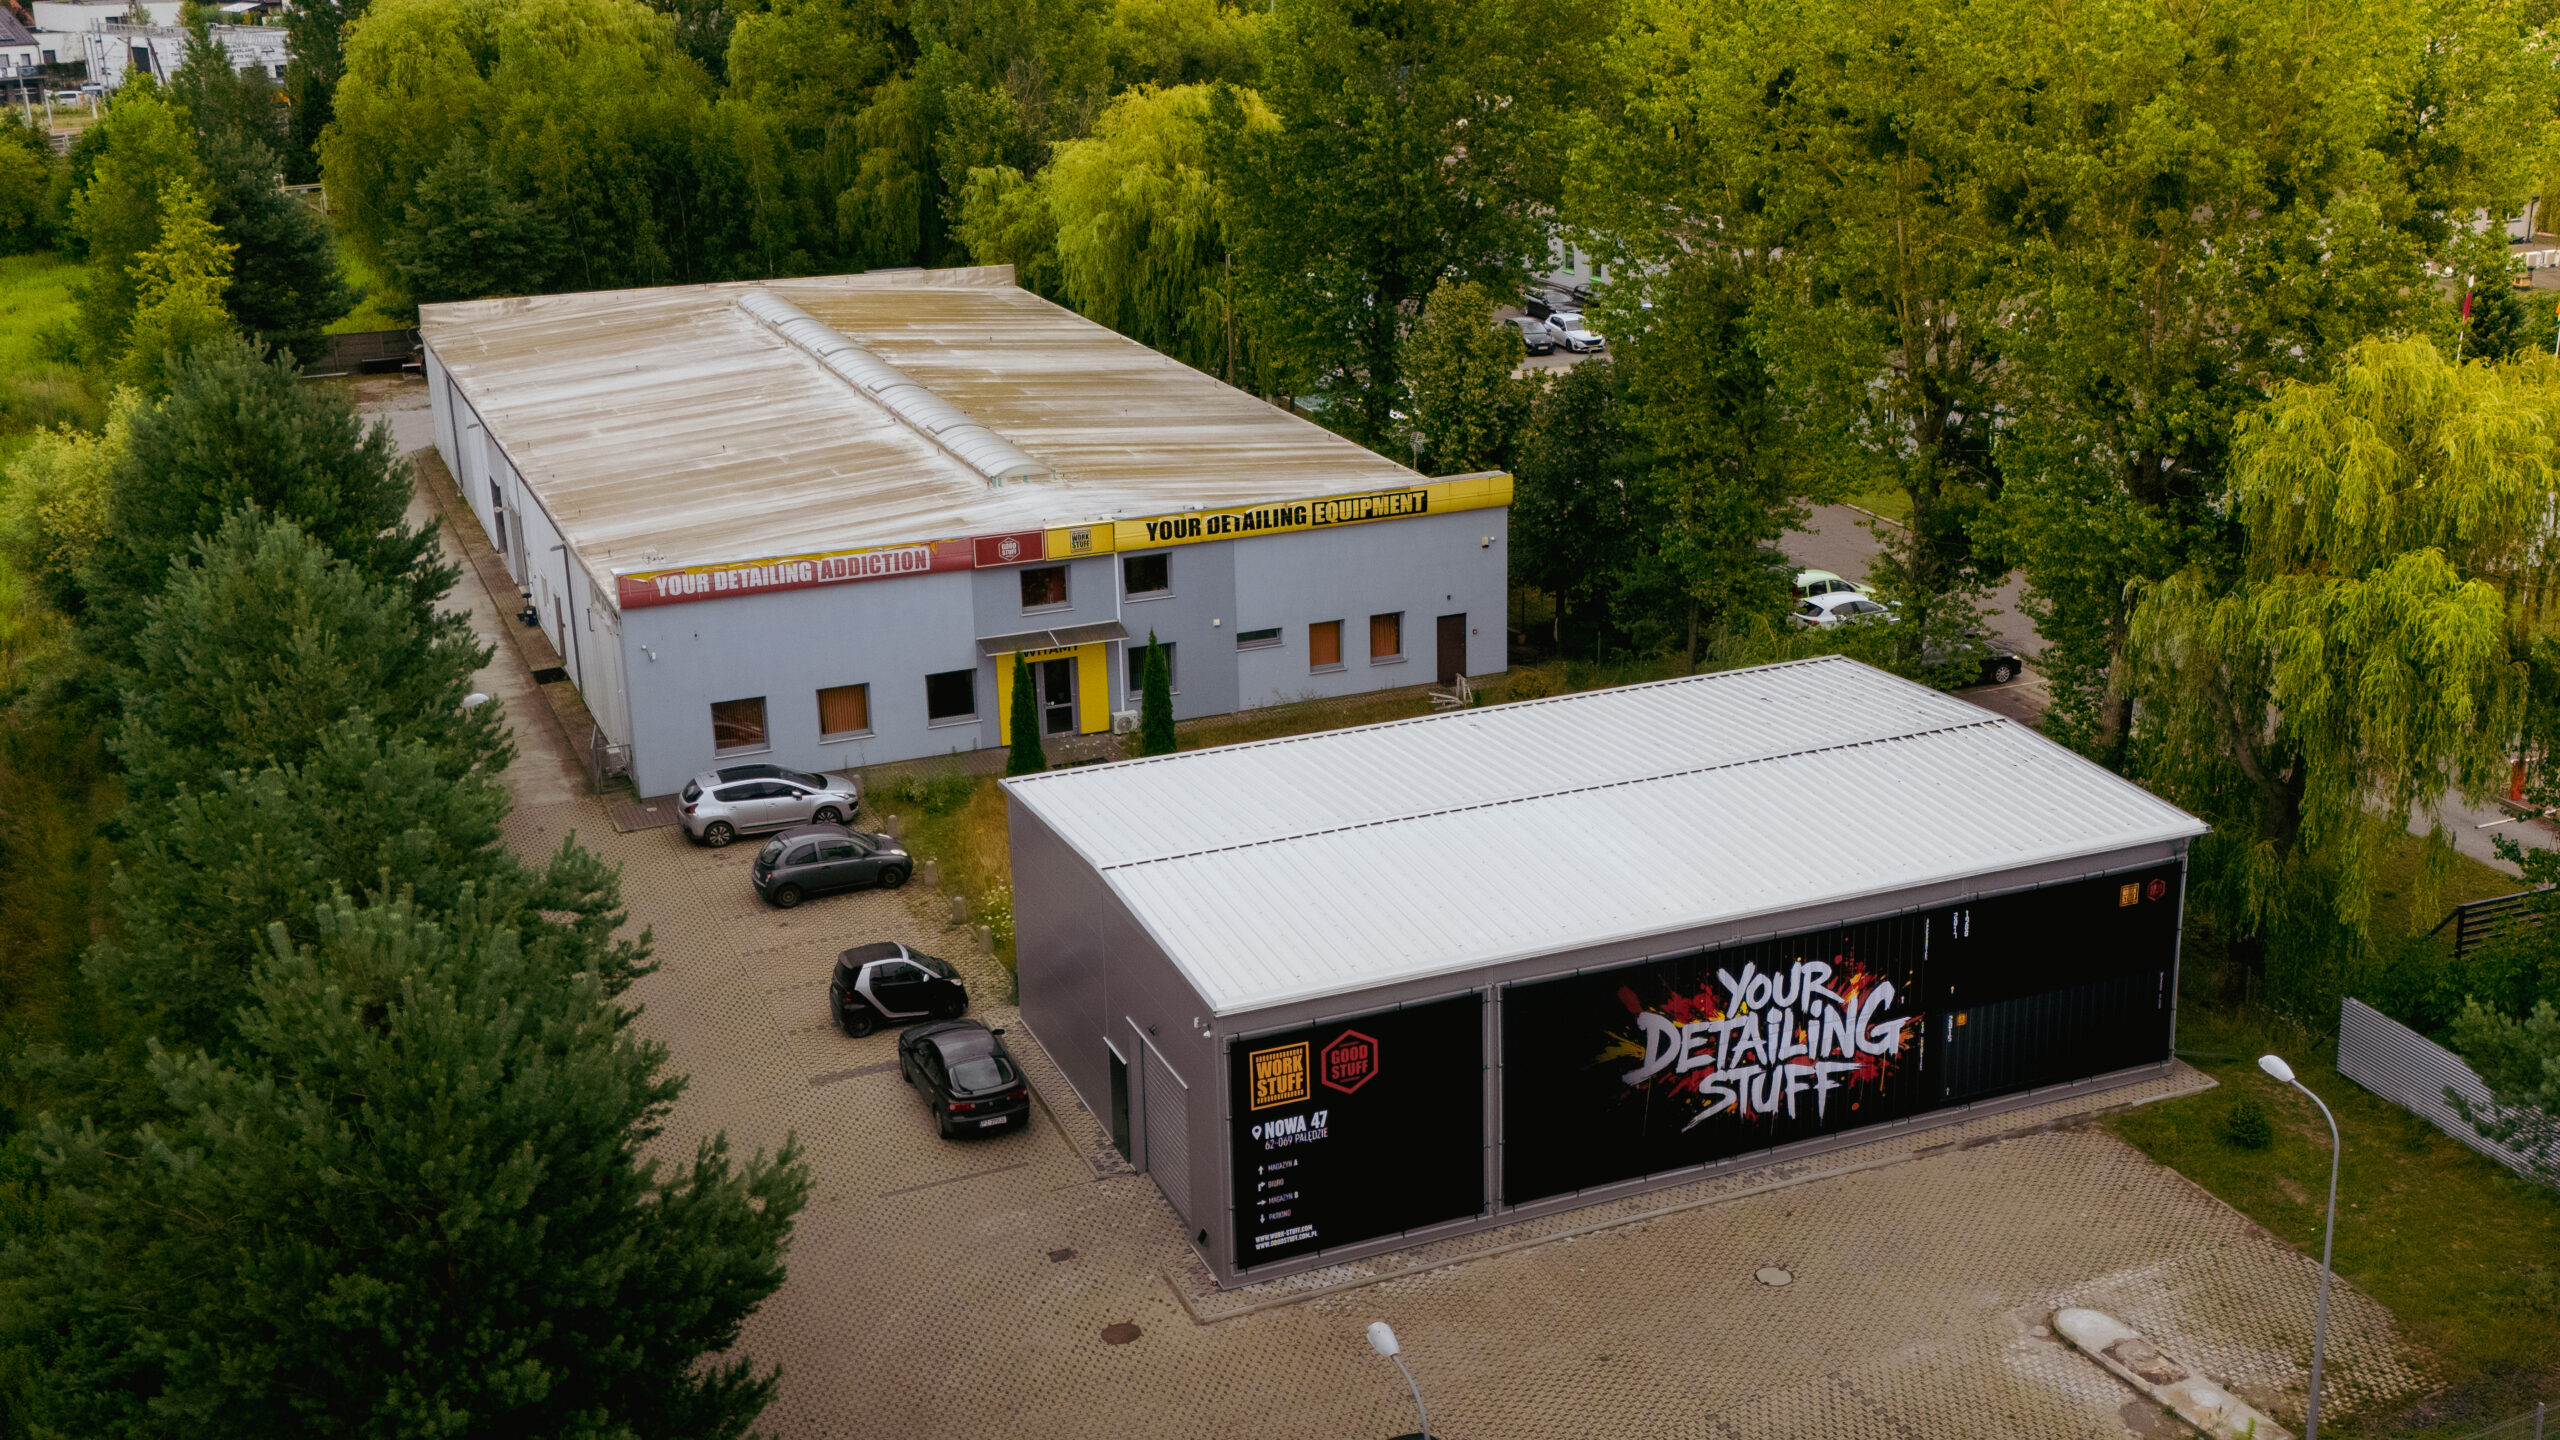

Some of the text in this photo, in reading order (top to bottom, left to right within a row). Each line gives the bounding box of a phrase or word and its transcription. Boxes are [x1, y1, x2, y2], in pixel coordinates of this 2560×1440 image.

[1146, 491, 1425, 541] YOUR DETAILING EQUIPMENT
[1071, 533, 1089, 542] WORK
[1071, 541, 1090, 549] STUFF
[655, 549, 927, 597] YOUR DETAILING ADDICTION
[1717, 960, 1845, 1020] YOUR
[1331, 1044, 1368, 1065] GOOD
[1256, 1055, 1303, 1080] WORK
[1331, 1059, 1368, 1080] STUFF
[1257, 1072, 1304, 1098] STUFF
[1681, 1061, 1868, 1133] STUFF
[1264, 1110, 1328, 1139] NOWA 47
[1265, 1134, 1293, 1150] 62-069
